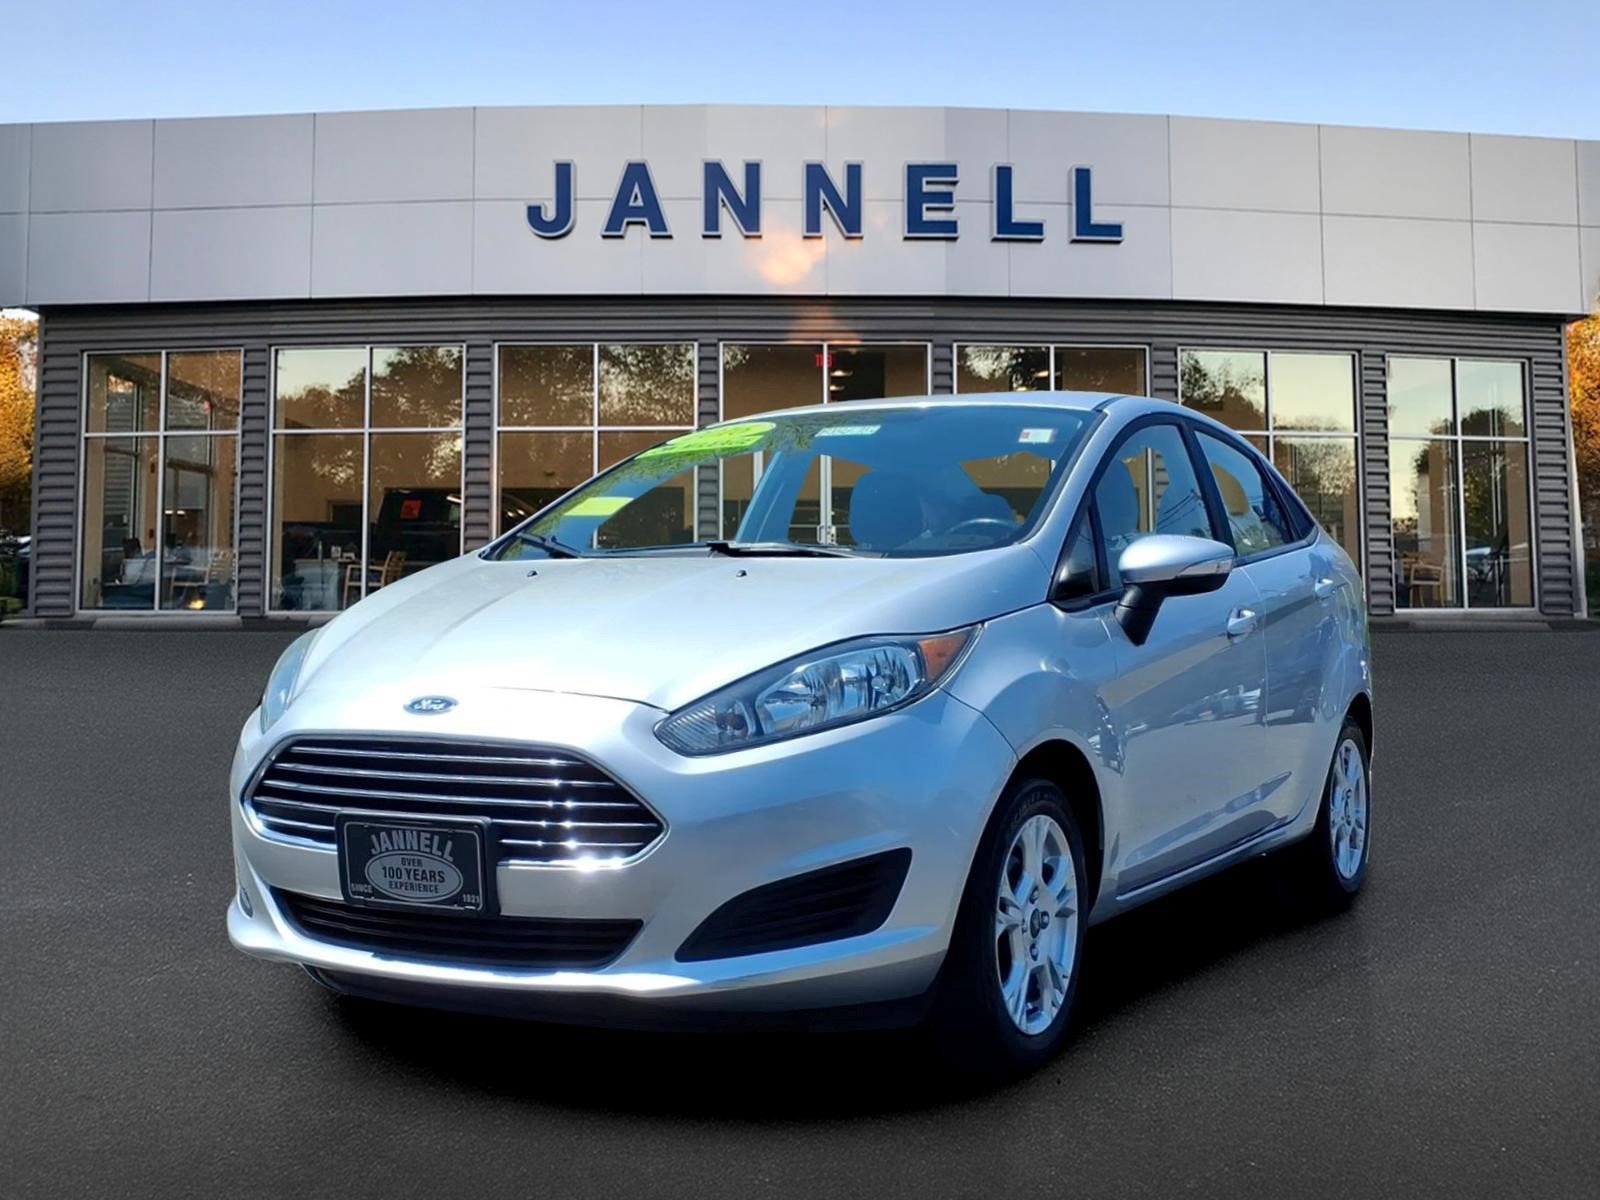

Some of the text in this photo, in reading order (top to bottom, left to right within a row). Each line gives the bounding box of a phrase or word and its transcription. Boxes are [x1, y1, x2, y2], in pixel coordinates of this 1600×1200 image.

[525, 159, 1124, 243] JANNELL
[371, 830, 453, 862] JANNELL
[401, 858, 424, 867] OVER
[383, 867, 445, 883] 100 YEARS
[352, 883, 373, 893] SINCE
[388, 881, 438, 893] EXPERIENCE
